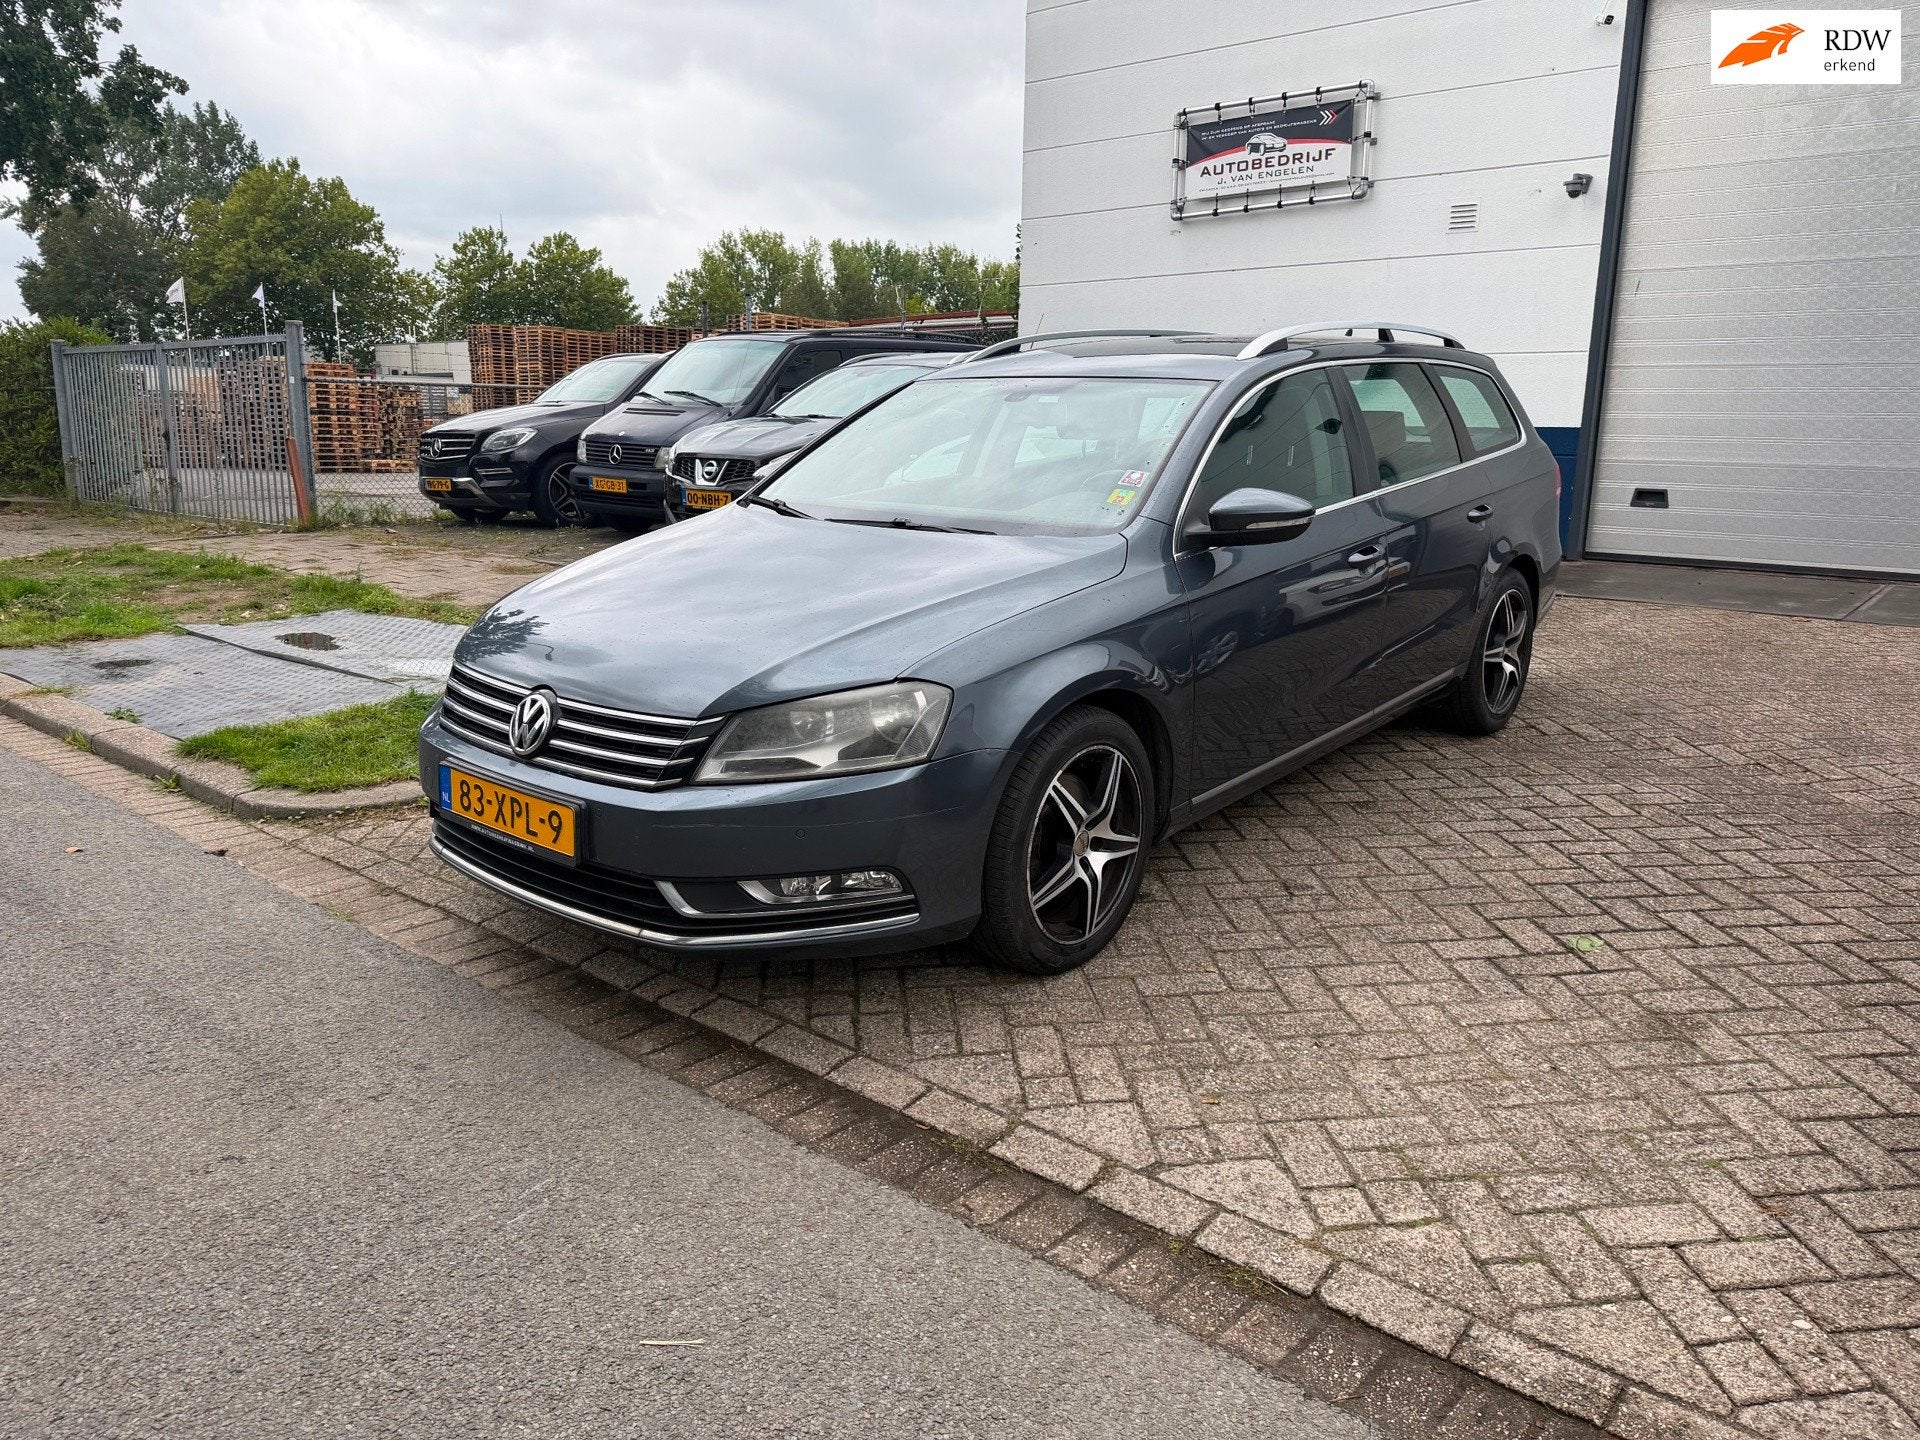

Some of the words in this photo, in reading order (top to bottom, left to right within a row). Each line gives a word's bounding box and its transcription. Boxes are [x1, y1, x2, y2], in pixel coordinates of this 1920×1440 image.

[1200, 147, 1336, 178] AUTOBEDRIJF
[1217, 177, 1227, 185] J.
[1230, 173, 1253, 183] VAN
[1258, 165, 1314, 180] ENGELEN
[687, 492, 729, 506] 00-NBH-7
[442, 791, 451, 803] NL
[459, 779, 563, 844] 83-XPL-9
